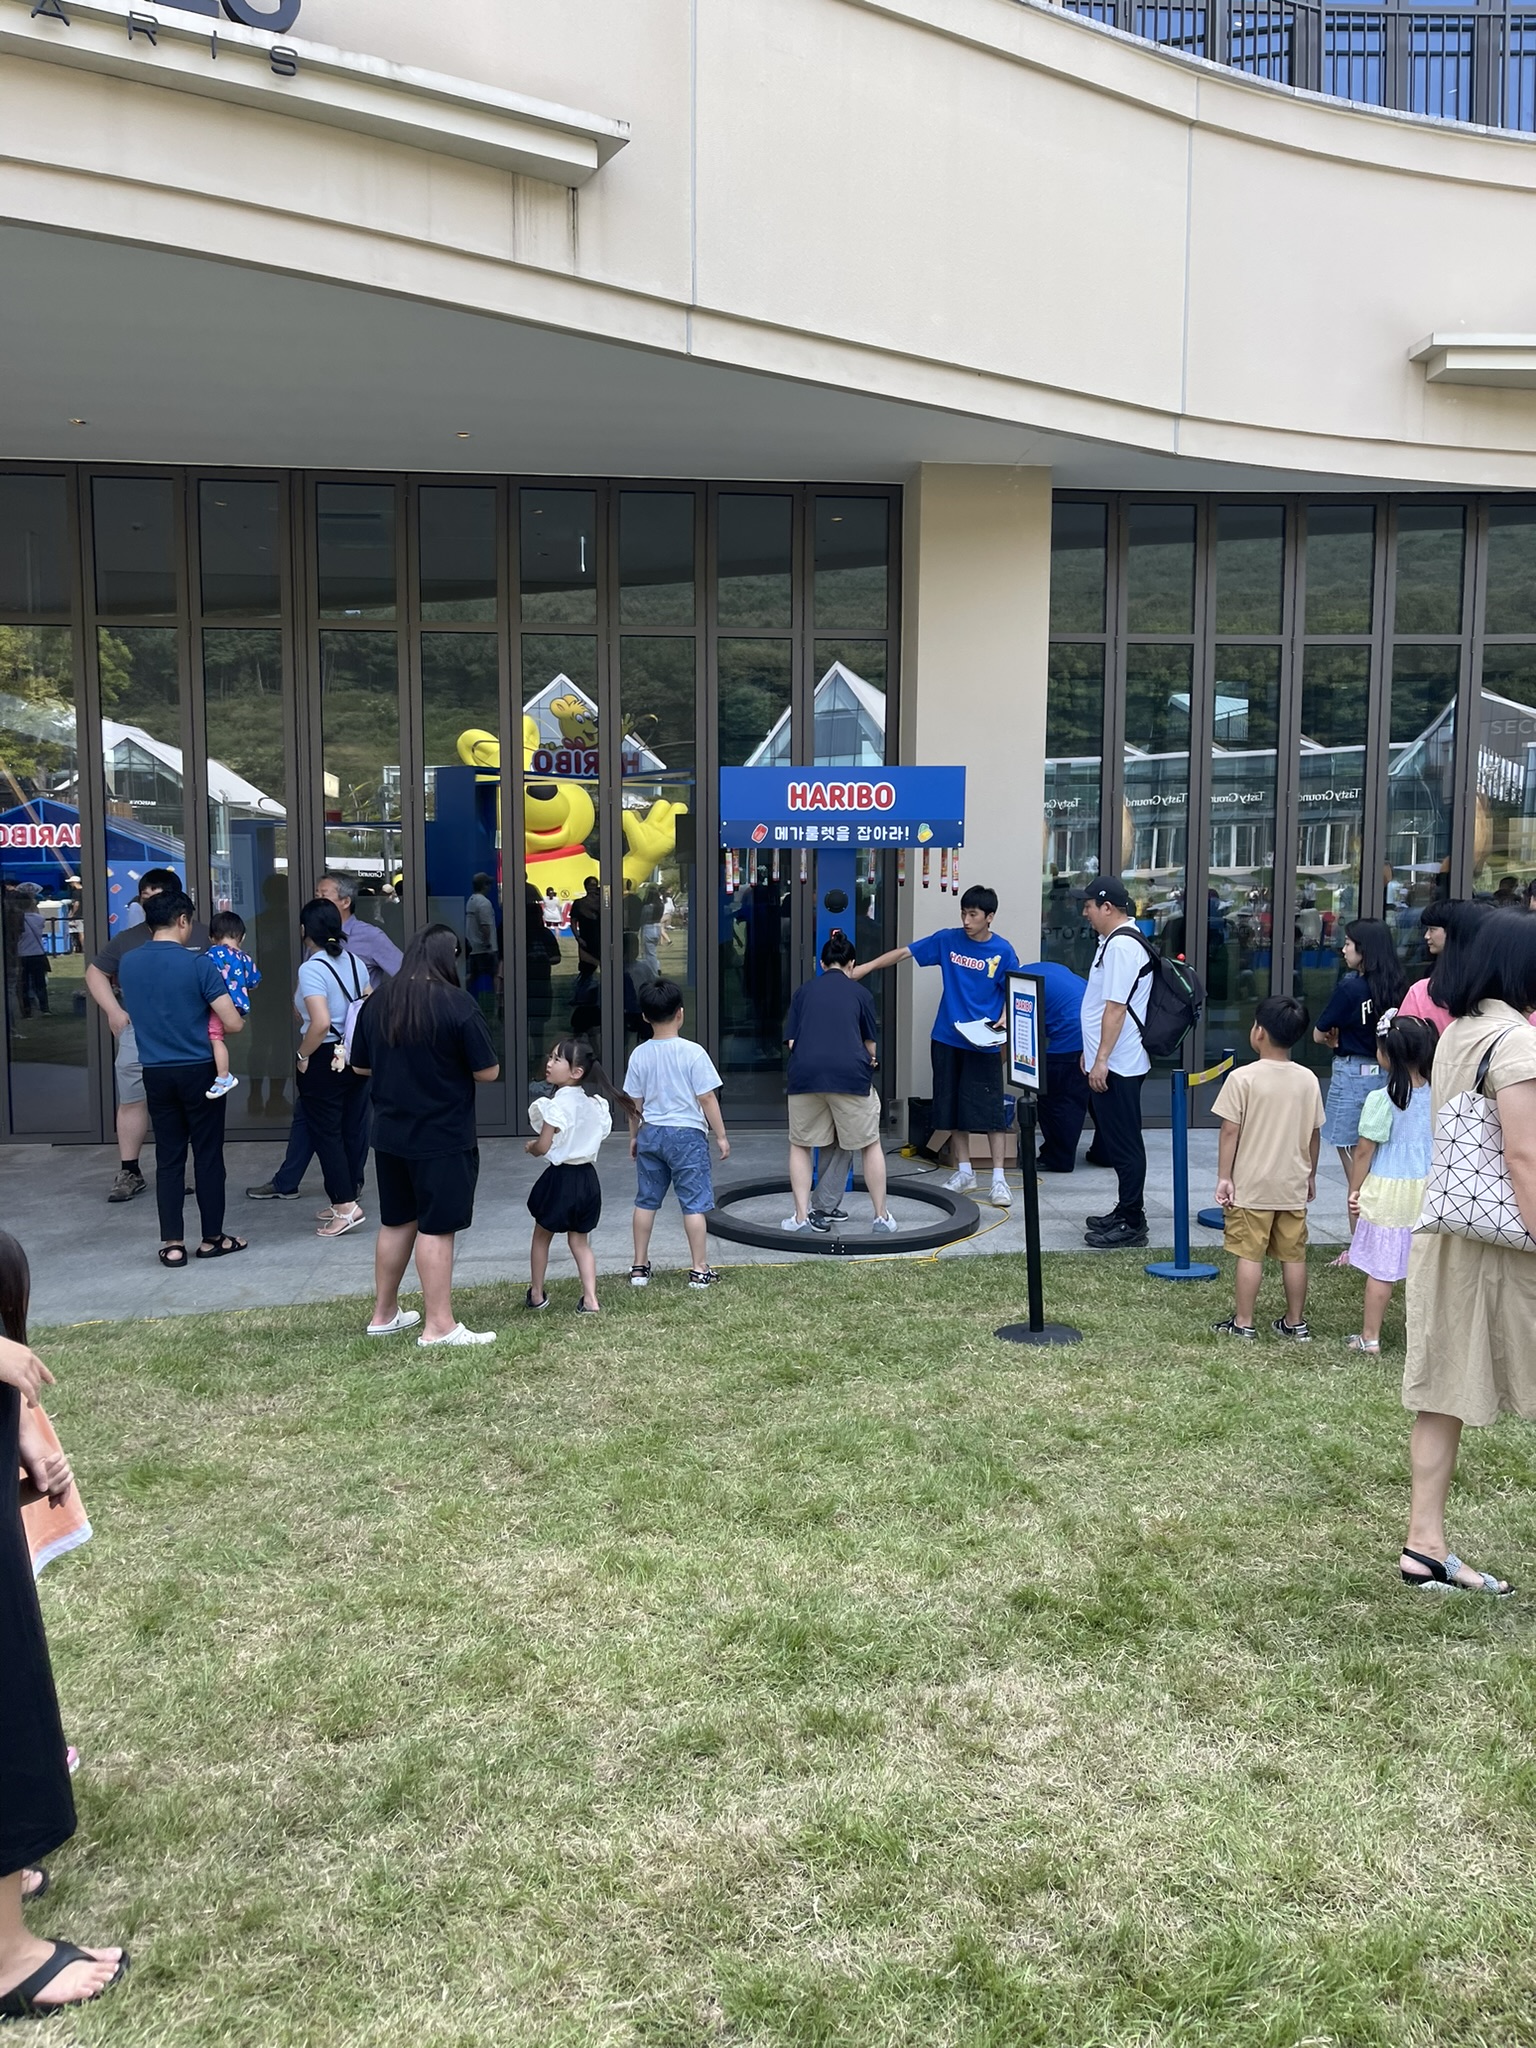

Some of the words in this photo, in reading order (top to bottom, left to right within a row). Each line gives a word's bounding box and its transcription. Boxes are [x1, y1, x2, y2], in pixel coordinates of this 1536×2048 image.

[1491, 719, 1536, 735] SEC
[788, 782, 896, 811] HARIBO
[774, 826, 850, 842] 메가룰렛을
[857, 825, 910, 842] 잡아라!
[950, 951, 986, 971] HARIBO
